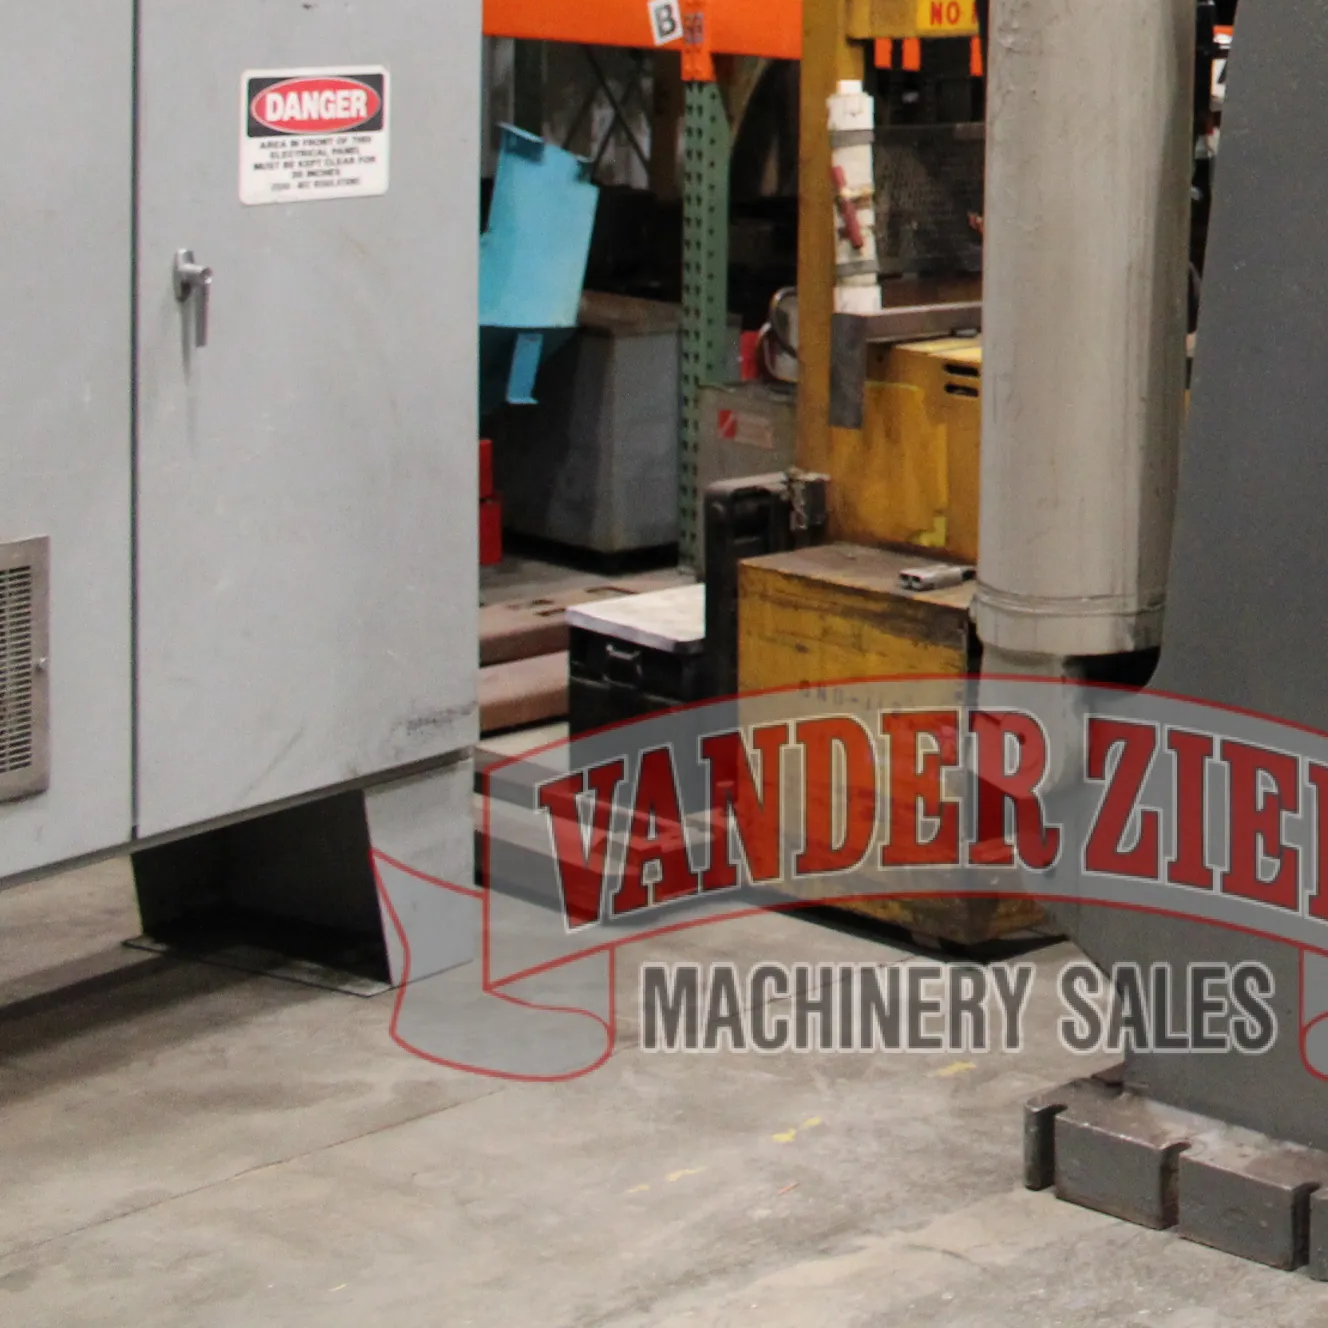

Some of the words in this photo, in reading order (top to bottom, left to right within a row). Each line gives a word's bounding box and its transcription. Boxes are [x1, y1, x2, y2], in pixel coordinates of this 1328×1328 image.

[654, 4, 677, 38] B
[930, 1, 960, 26] NO
[265, 89, 368, 122] DANGER
